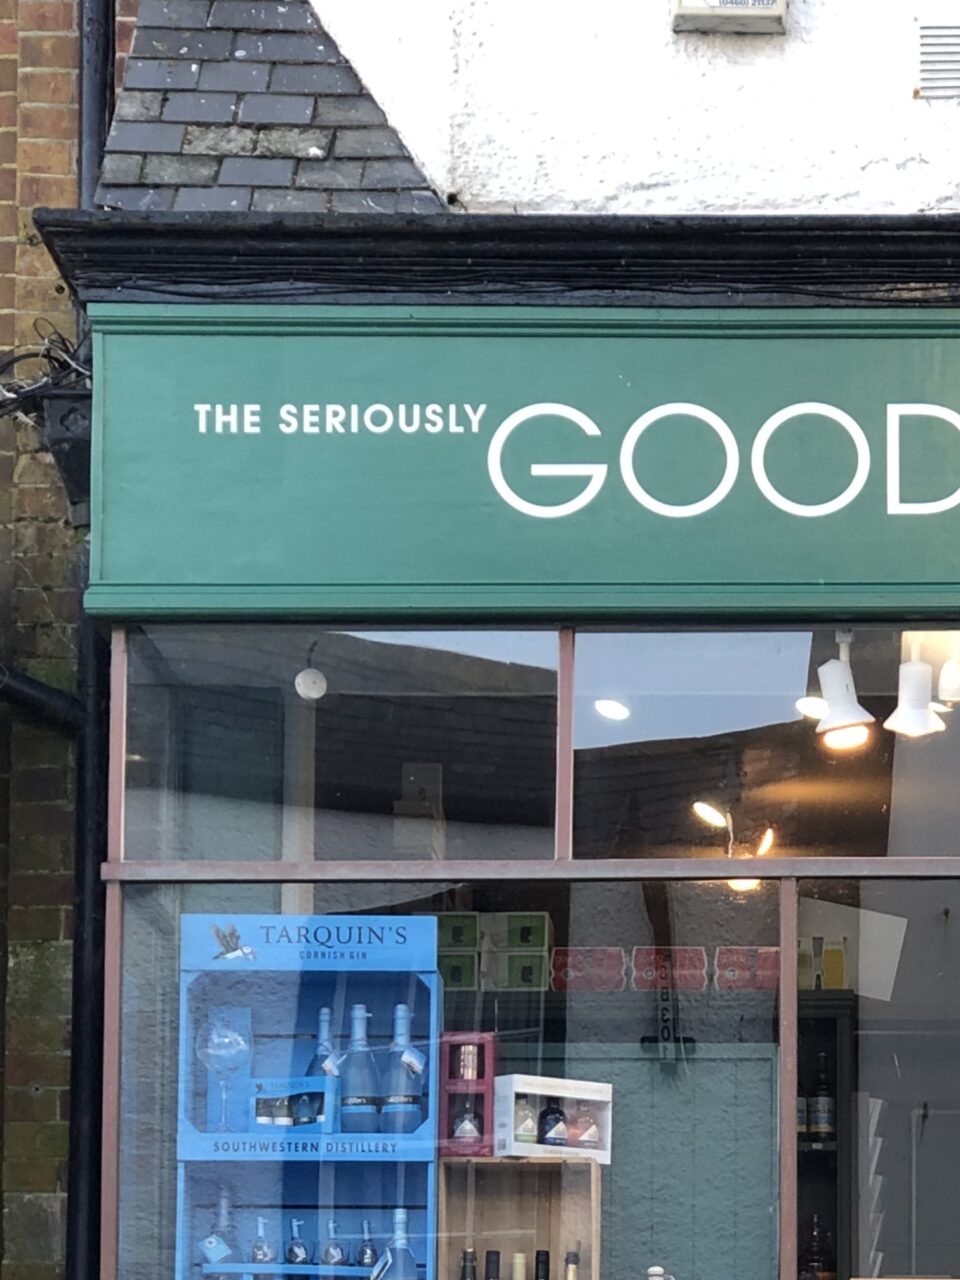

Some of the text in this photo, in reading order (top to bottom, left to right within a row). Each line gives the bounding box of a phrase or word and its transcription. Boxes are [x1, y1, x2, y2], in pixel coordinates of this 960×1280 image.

[193, 403, 261, 434] THE
[278, 403, 487, 434] SERIOUSLY
[260, 926, 407, 949] TARQUIN'S
[299, 951, 367, 960] CORNISH GIN
[213, 1141, 398, 1153] SOUTHWESTERN DISTILLERY
